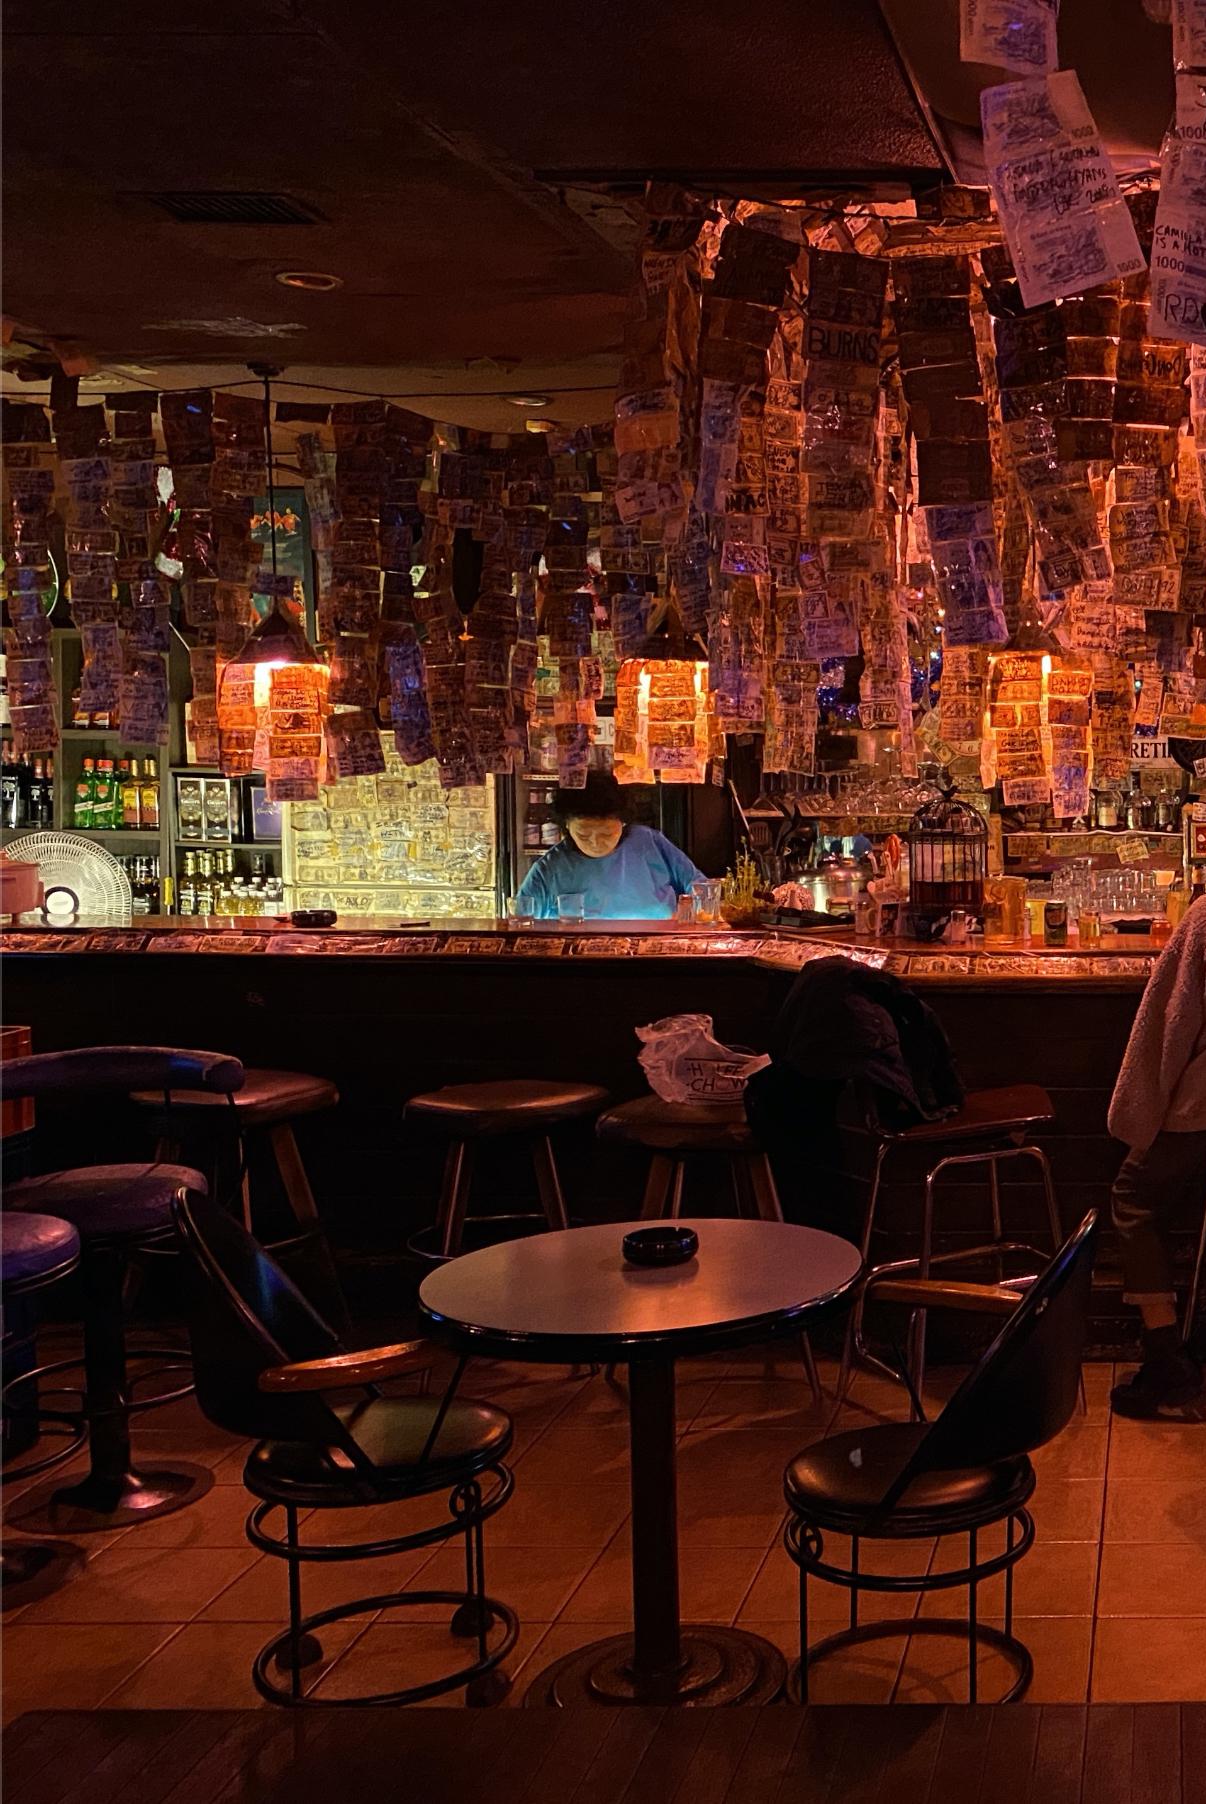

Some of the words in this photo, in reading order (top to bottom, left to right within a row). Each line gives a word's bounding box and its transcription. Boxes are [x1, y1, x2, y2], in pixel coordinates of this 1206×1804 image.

[1173, 241, 1180, 250] A
[1156, 256, 1185, 273] 1000
[808, 326, 880, 365] BURNS
[1130, 742, 1173, 759] RETI
